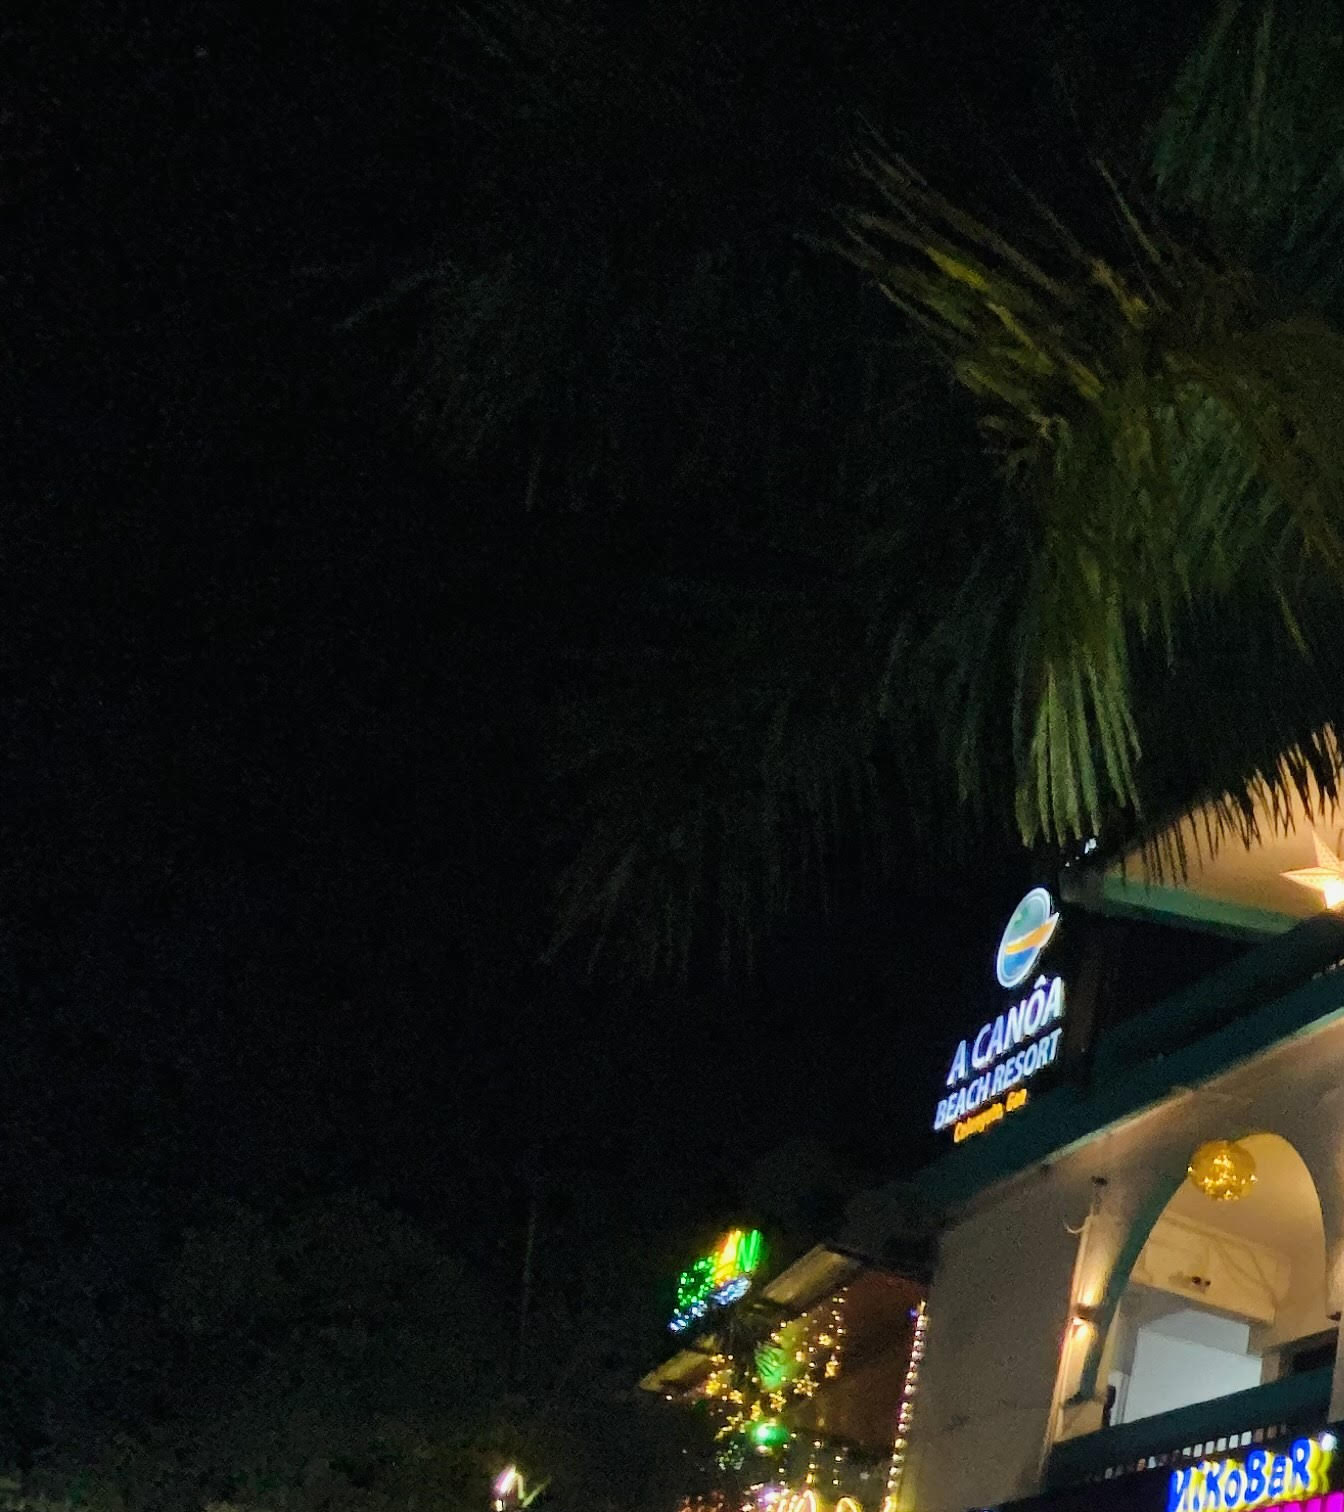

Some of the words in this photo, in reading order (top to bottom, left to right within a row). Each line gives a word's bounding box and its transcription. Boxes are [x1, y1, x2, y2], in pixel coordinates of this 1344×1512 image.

[934, 1074, 991, 1130] BEACH
[991, 1027, 1062, 1097] RESORT
[947, 1040, 968, 1086] A
[971, 975, 1064, 1068] CANÔA
